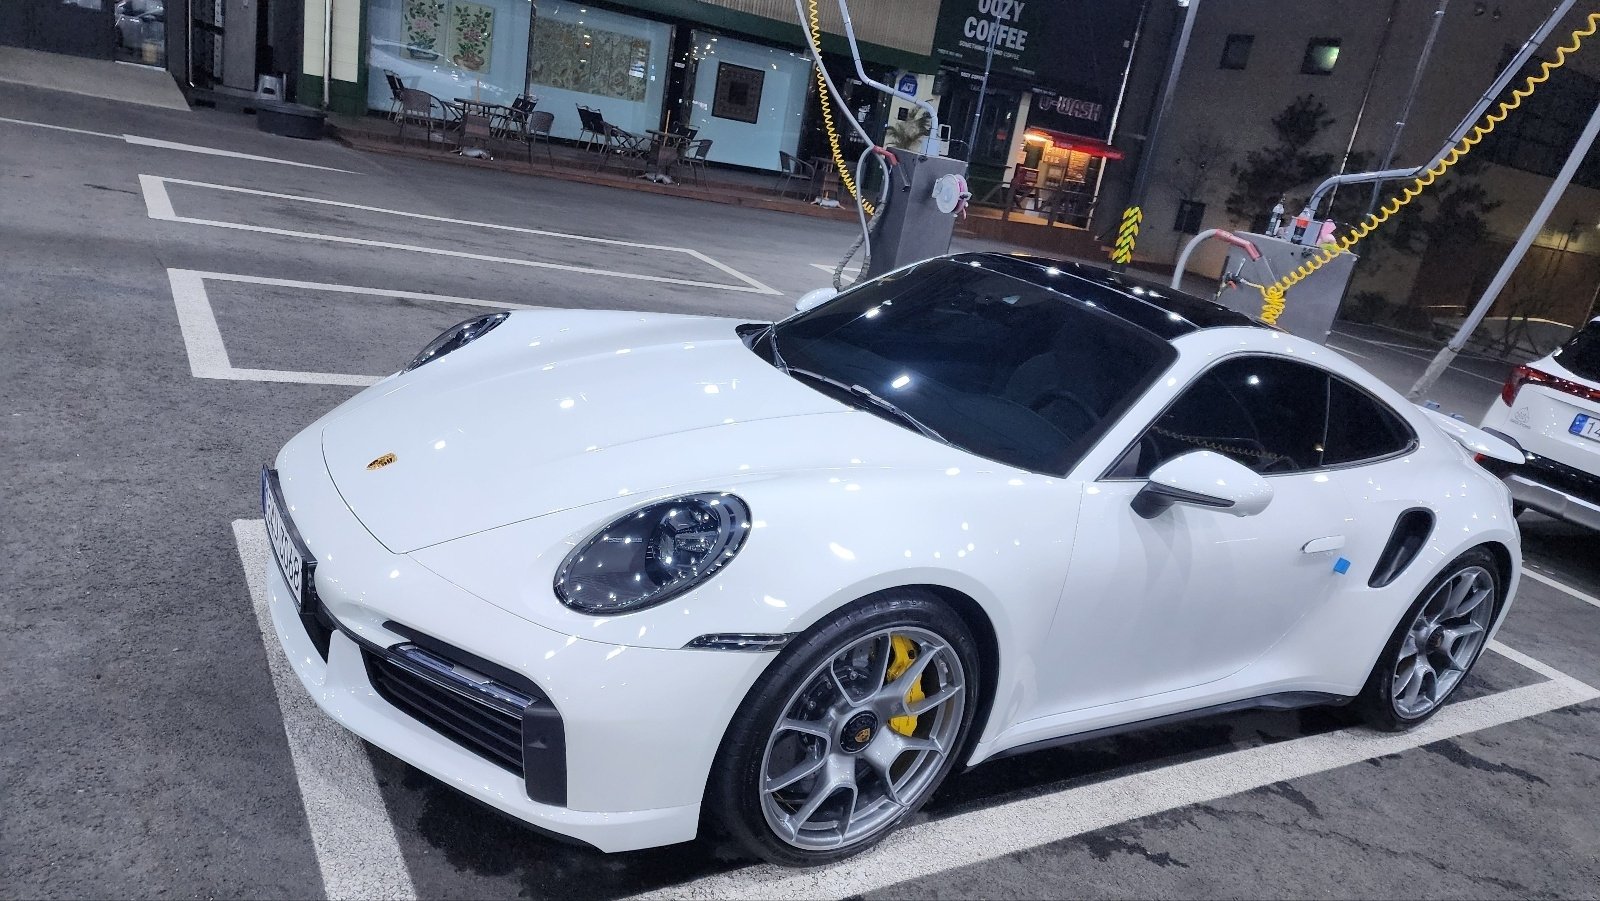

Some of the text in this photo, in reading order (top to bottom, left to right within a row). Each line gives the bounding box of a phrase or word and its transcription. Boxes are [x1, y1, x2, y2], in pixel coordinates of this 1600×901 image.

[963, 16, 1028, 51] COFFEE
[900, 82, 916, 92] ADT
[1039, 95, 1102, 121] U-WASH
